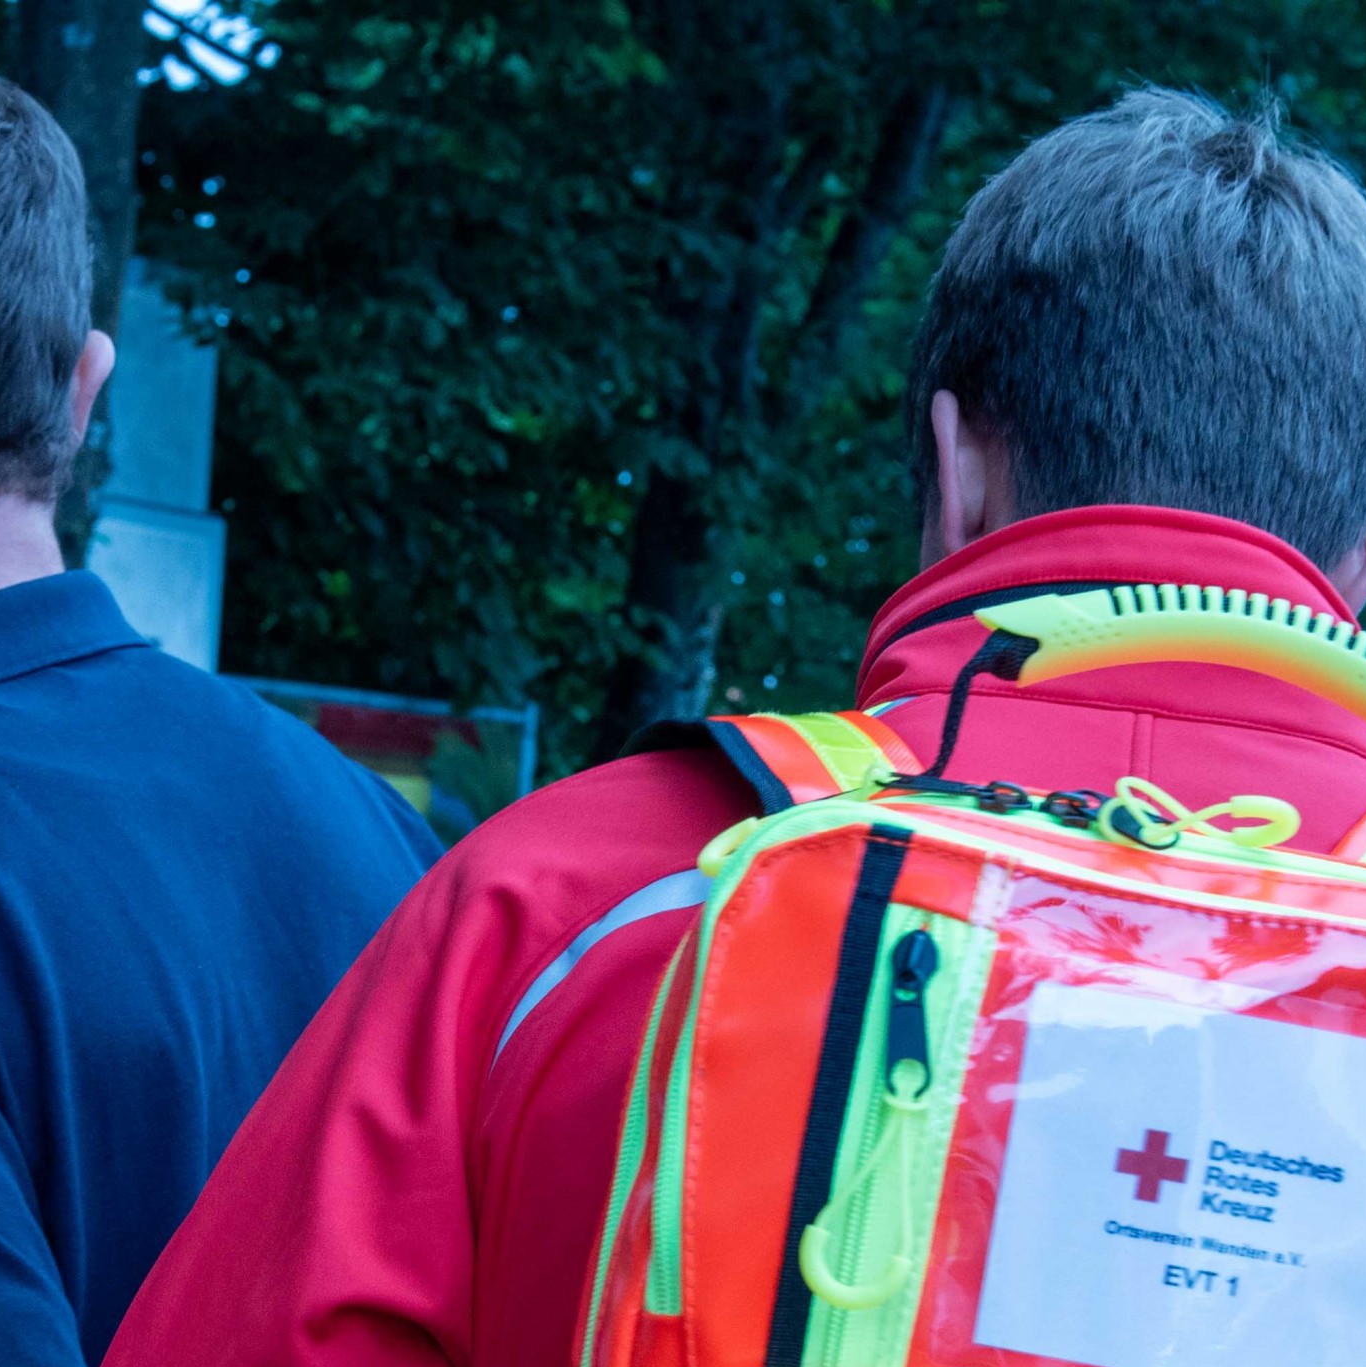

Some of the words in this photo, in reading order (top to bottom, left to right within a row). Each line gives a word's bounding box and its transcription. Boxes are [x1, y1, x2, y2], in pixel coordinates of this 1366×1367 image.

[1208, 1140, 1345, 1183] Deutsches
[1204, 1166, 1280, 1198] Rotes
[1199, 1191, 1276, 1223] Kreuz
[1163, 1264, 1219, 1293] EVT
[1226, 1275, 1240, 1297] 1
